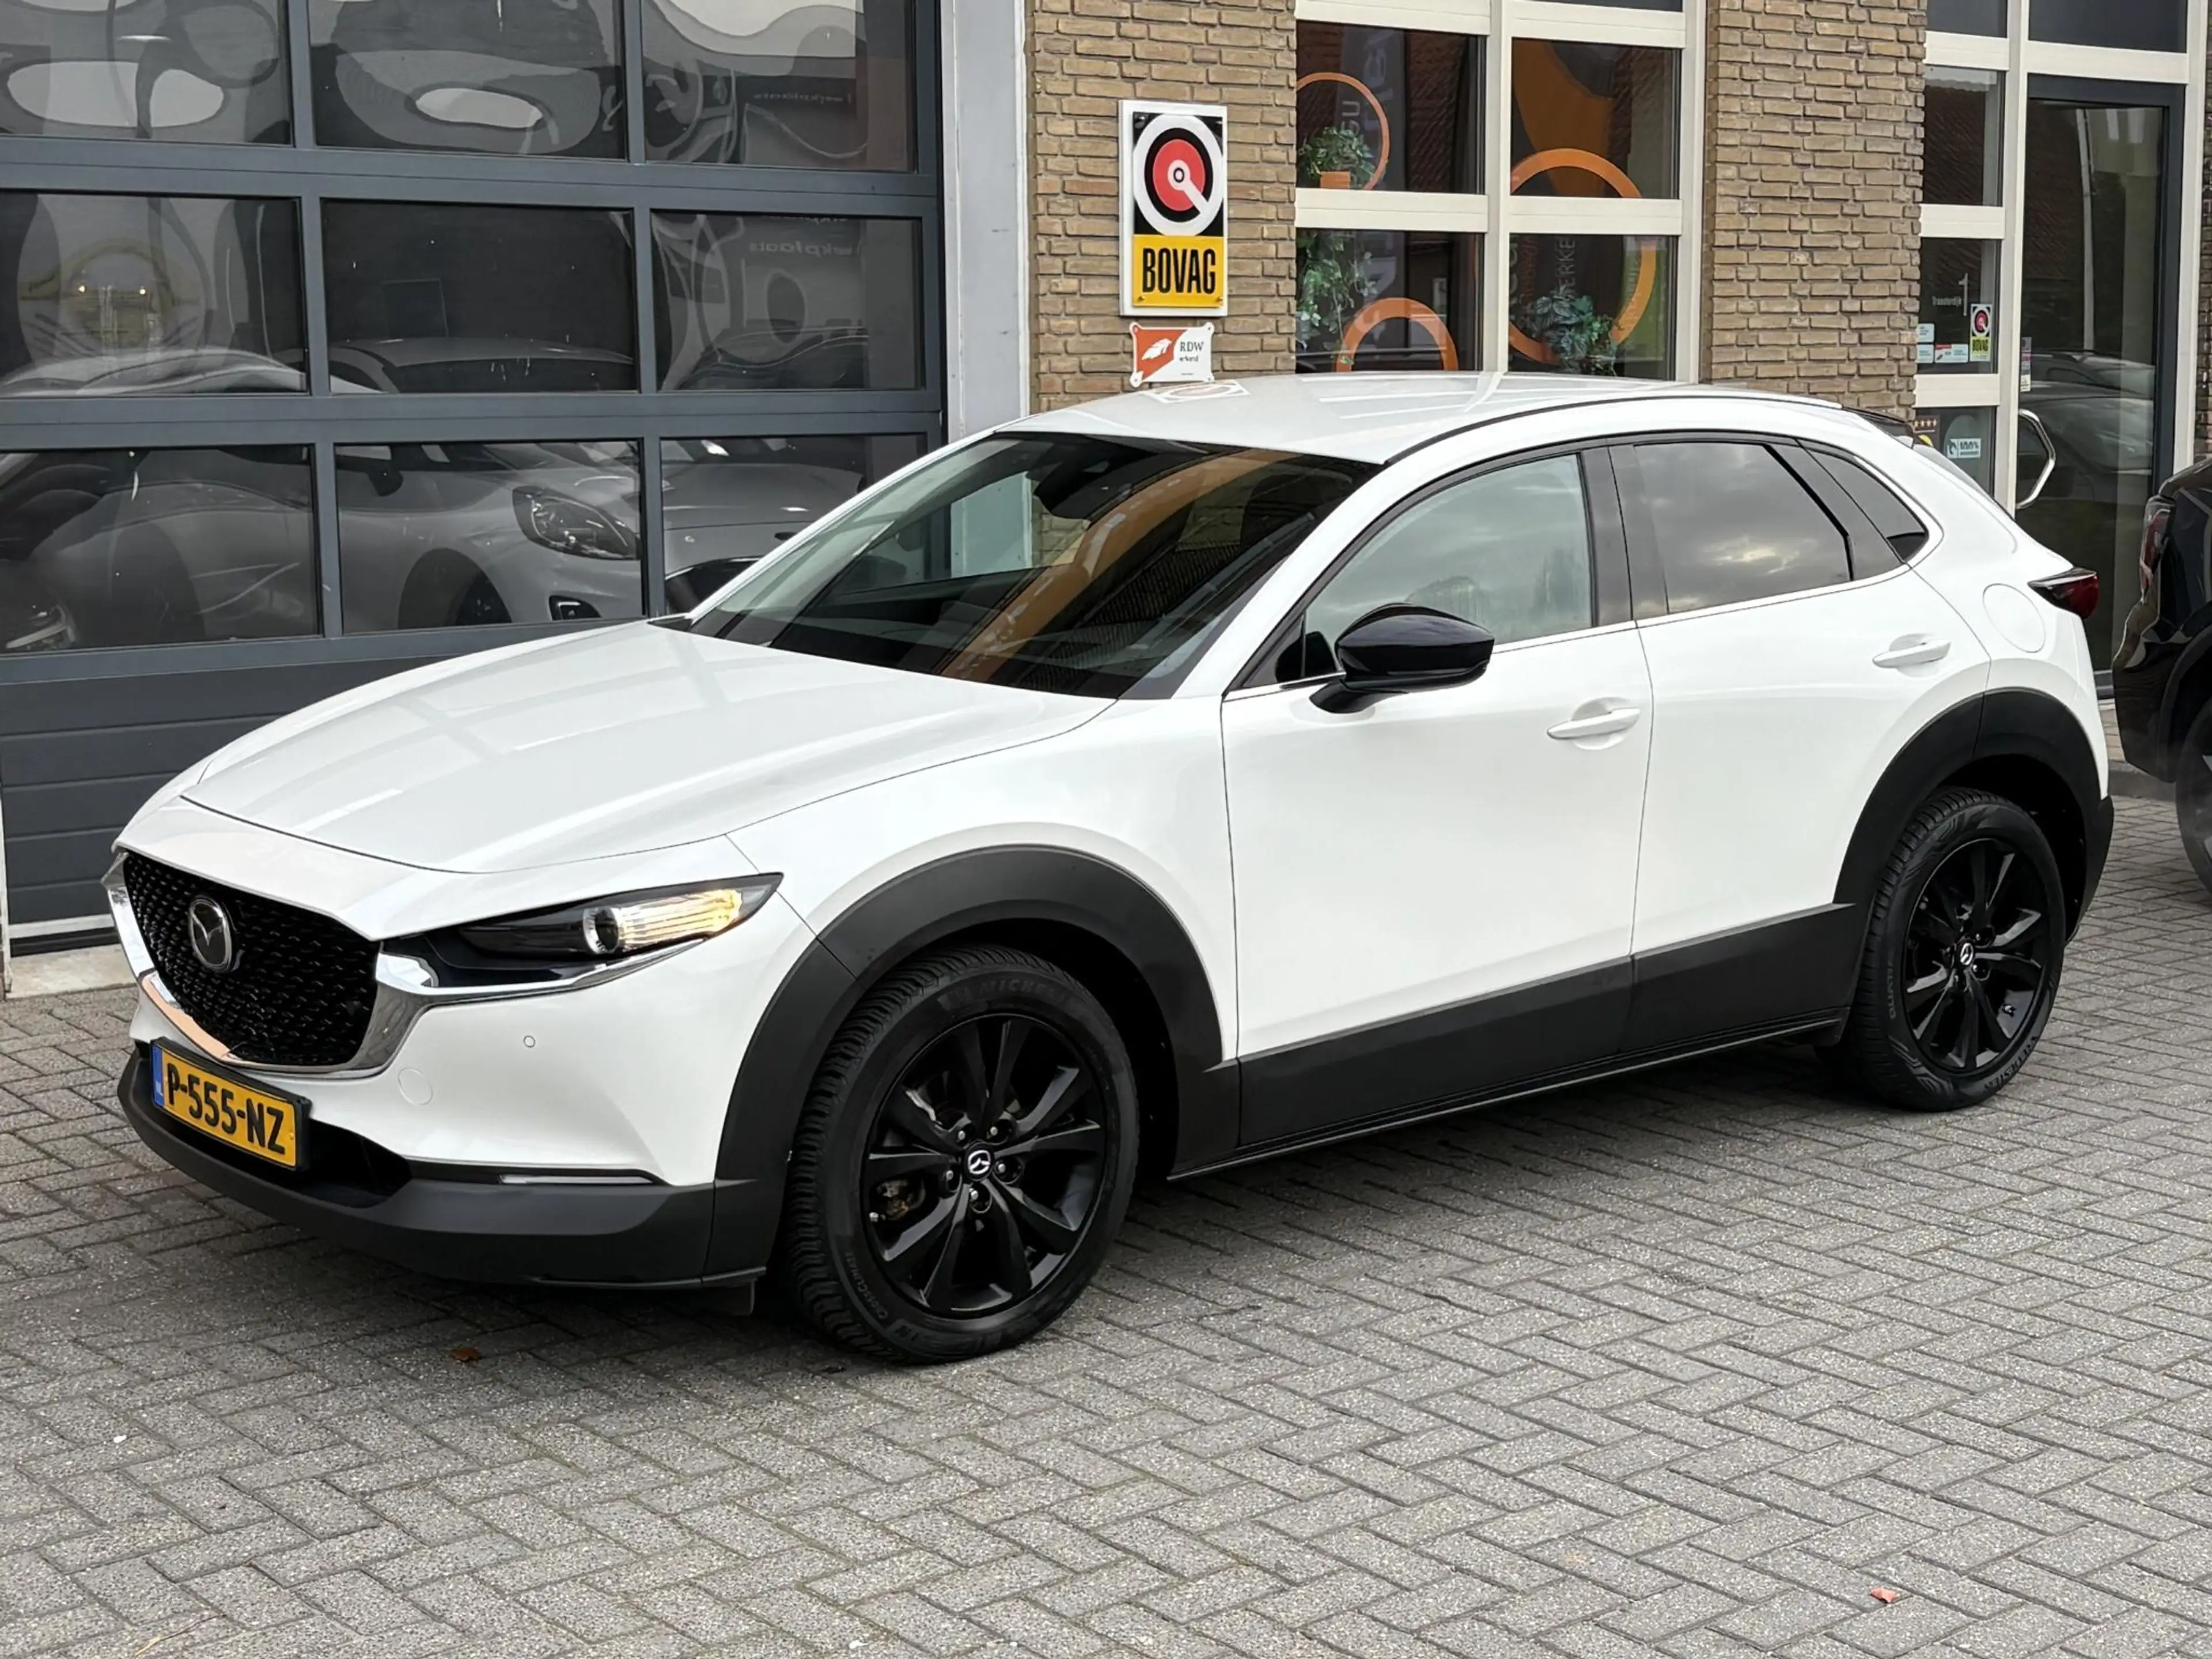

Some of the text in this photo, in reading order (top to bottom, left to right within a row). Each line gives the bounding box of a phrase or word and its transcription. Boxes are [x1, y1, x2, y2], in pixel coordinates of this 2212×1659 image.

[1142, 248, 1216, 295] BOVAG
[1180, 341, 1204, 352] RDW
[166, 1062, 286, 1156] P-555-NZ
